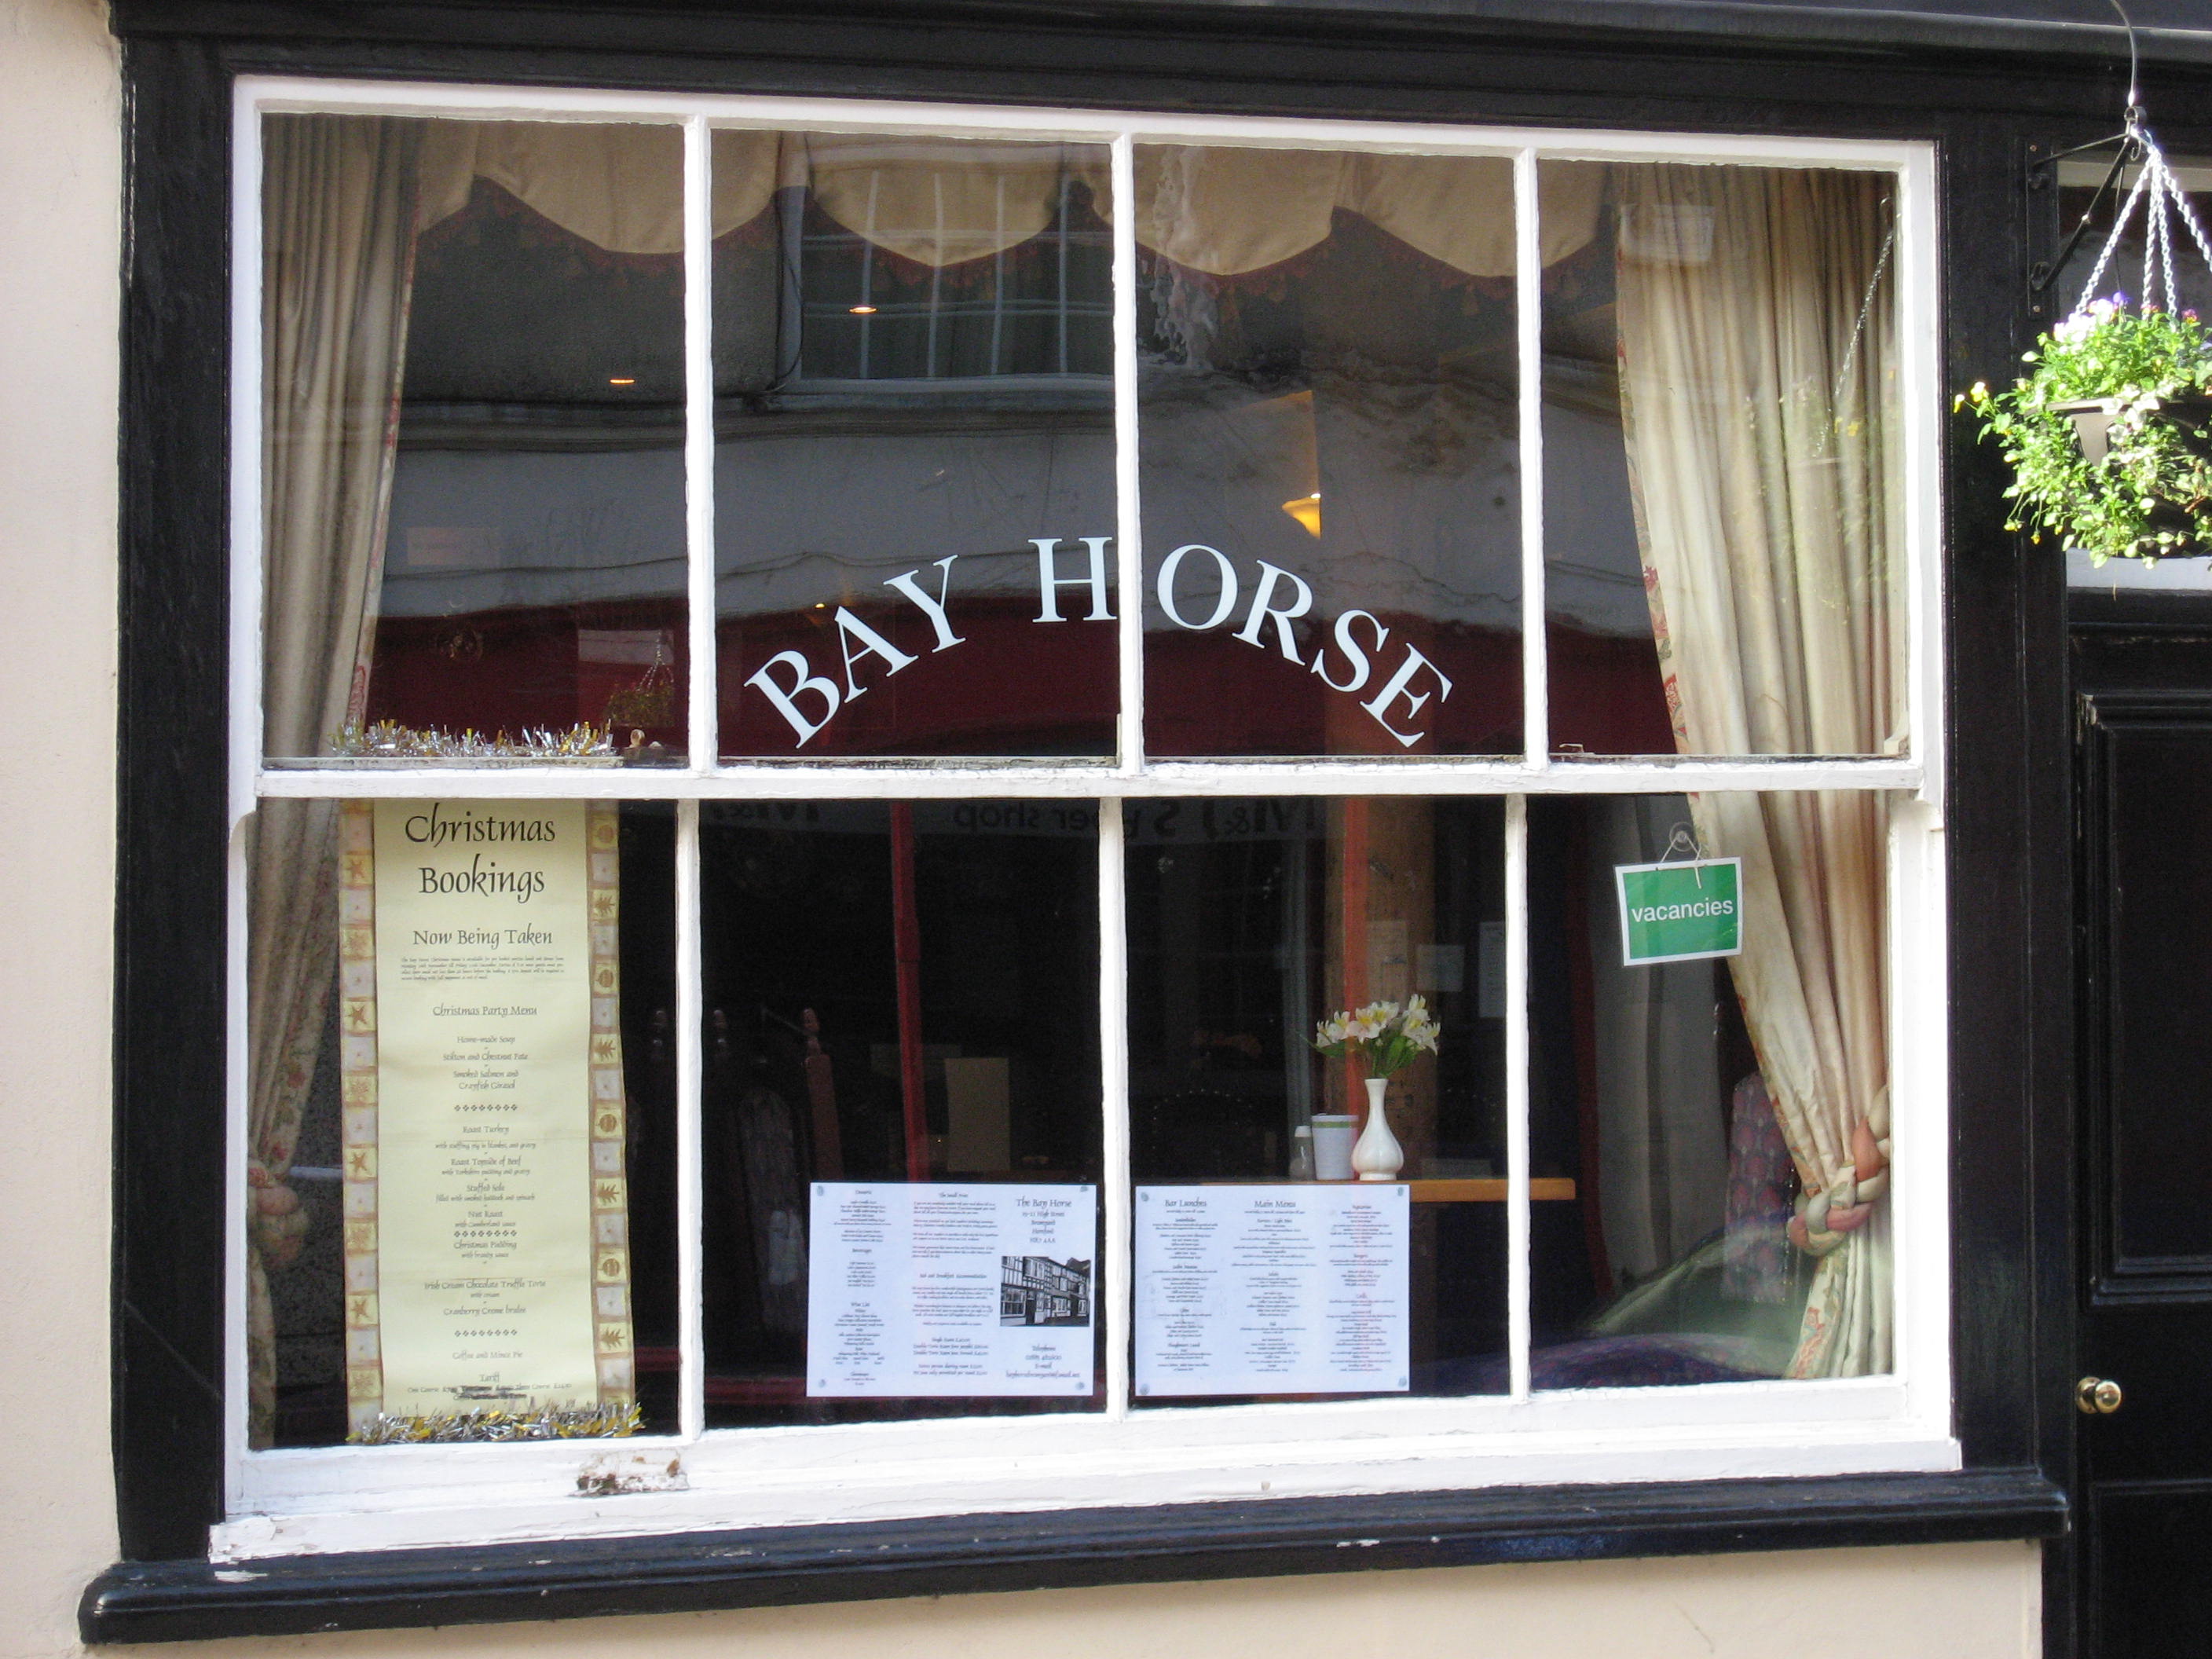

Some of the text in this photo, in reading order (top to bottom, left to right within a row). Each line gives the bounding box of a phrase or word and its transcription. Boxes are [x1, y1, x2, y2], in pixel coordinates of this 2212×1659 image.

[745, 537, 1452, 749] BAY HORSE
[405, 803, 556, 848] Christmas
[419, 853, 545, 903] Bookings
[1632, 898, 1734, 923] vacancies
[413, 923, 552, 950] Now Being Taken
[433, 1003, 538, 1018] Christmas Party Menu
[1016, 1196, 1072, 1210] The Bay Horse
